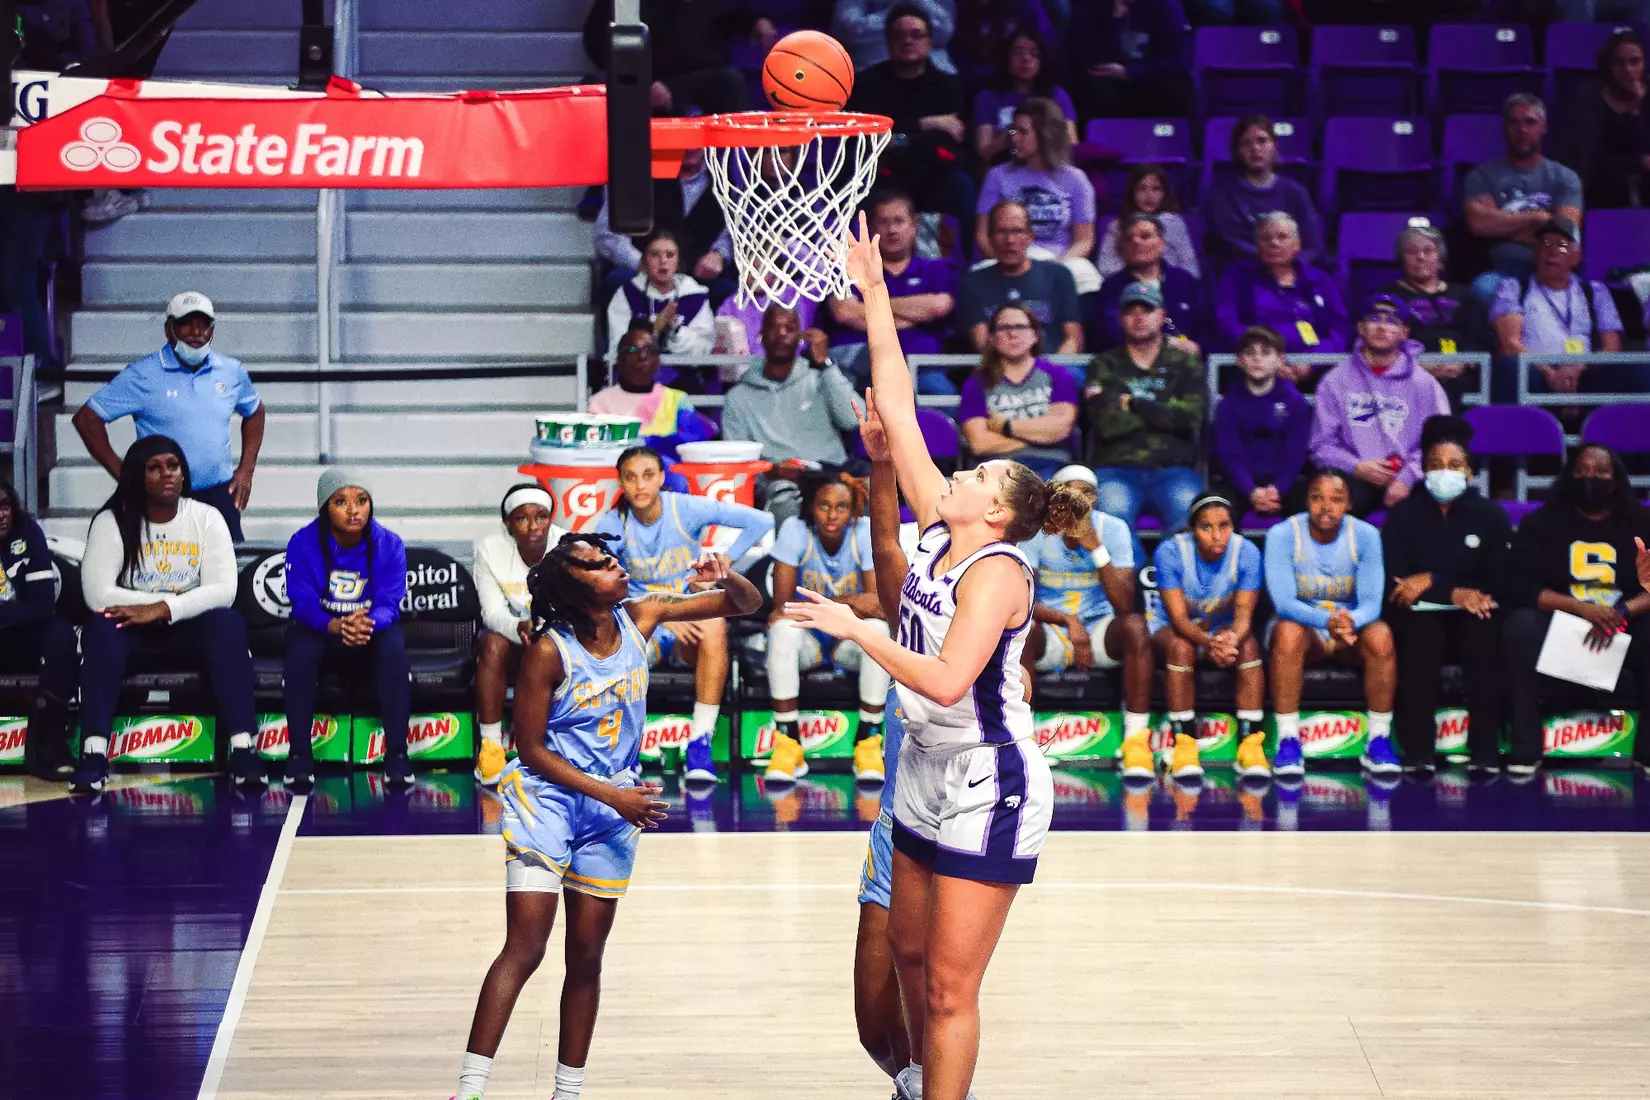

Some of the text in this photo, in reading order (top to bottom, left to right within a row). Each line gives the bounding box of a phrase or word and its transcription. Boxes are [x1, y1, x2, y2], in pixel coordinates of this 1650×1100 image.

[569, 484, 597, 516] G
[406, 562, 457, 591] pitol
[400, 584, 459, 612] deral
[107, 719, 194, 760] LIBMAN
[597, 709, 623, 751] 4
[1036, 718, 1100, 744] BMAN
[1300, 718, 1360, 744] BMAN
[1542, 715, 1625, 751] LIBMAN
